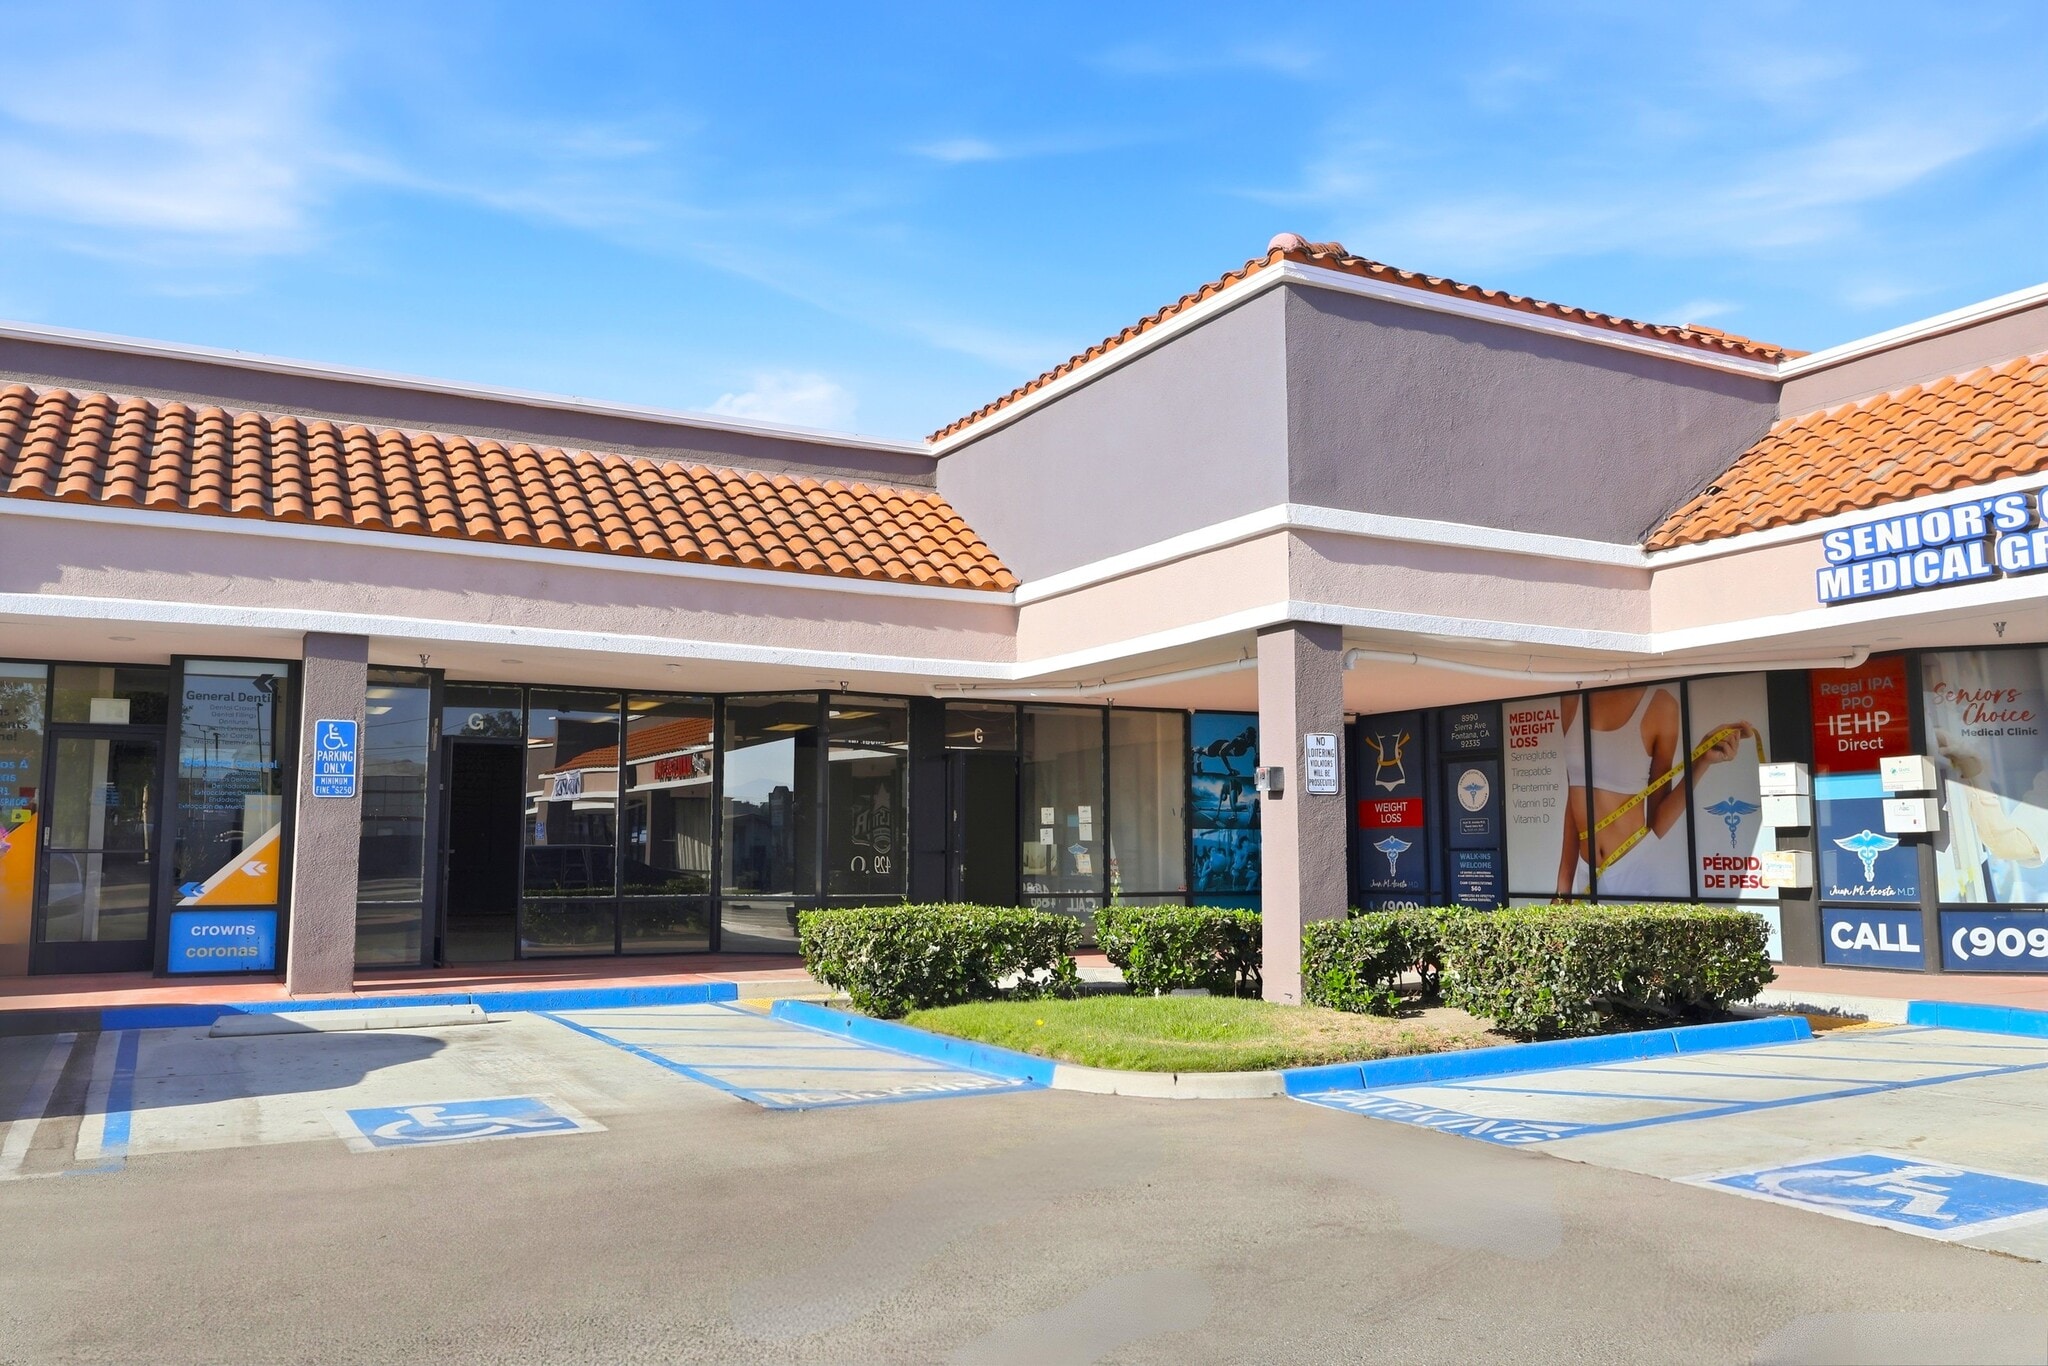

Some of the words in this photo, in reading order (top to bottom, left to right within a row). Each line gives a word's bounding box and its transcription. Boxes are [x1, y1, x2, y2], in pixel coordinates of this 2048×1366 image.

[1823, 493, 2030, 564] SENIOR'S
[1817, 540, 1992, 603] MEDICAL
[1821, 679, 1863, 696] Regal
[1868, 676, 1894, 690] IPA
[186, 690, 235, 702] General
[238, 692, 282, 704] Dentit
[1932, 682, 2023, 705] Seniors
[1841, 695, 1874, 710] PPO
[1461, 713, 1479, 722] 8990
[1509, 709, 1559, 723] MEDICAL
[1963, 702, 2037, 726] Choice
[468, 713, 484, 730] G
[1828, 710, 1891, 736] IEHP
[974, 727, 983, 743] G
[1510, 723, 1555, 736] WEIGHT
[1961, 728, 2004, 737] Medical
[2007, 727, 2039, 736] Clinic
[1315, 736, 1326, 746] NO
[1451, 732, 1479, 740] Fontana,
[1460, 740, 1481, 748] 92335
[1510, 737, 1538, 748] LOSS
[1838, 736, 1884, 752] Direct
[317, 750, 354, 762] PARKING
[1308, 748, 1335, 758] LOITERING
[1511, 750, 1557, 761] Semaglutide
[323, 762, 346, 774] ONLY
[320, 777, 348, 785] MINIMUM
[315, 785, 330, 794] FINE
[1512, 783, 1559, 792] Phentermine
[1375, 802, 1408, 812] WEIGHT
[1513, 799, 1541, 808] Vitamin
[1542, 798, 1556, 807] B12
[1381, 813, 1402, 823] LOSS
[1513, 814, 1542, 823] Vitamin
[1543, 814, 1550, 823] D
[1703, 853, 1763, 871] PÉRDID
[1704, 874, 1726, 889] DE
[1829, 885, 1852, 896] Juan
[1865, 885, 1896, 896] Acosta
[191, 924, 256, 936] crowns
[1830, 921, 1921, 953] CALL
[1951, 926, 2048, 961] (909
[185, 946, 258, 958] coronas
